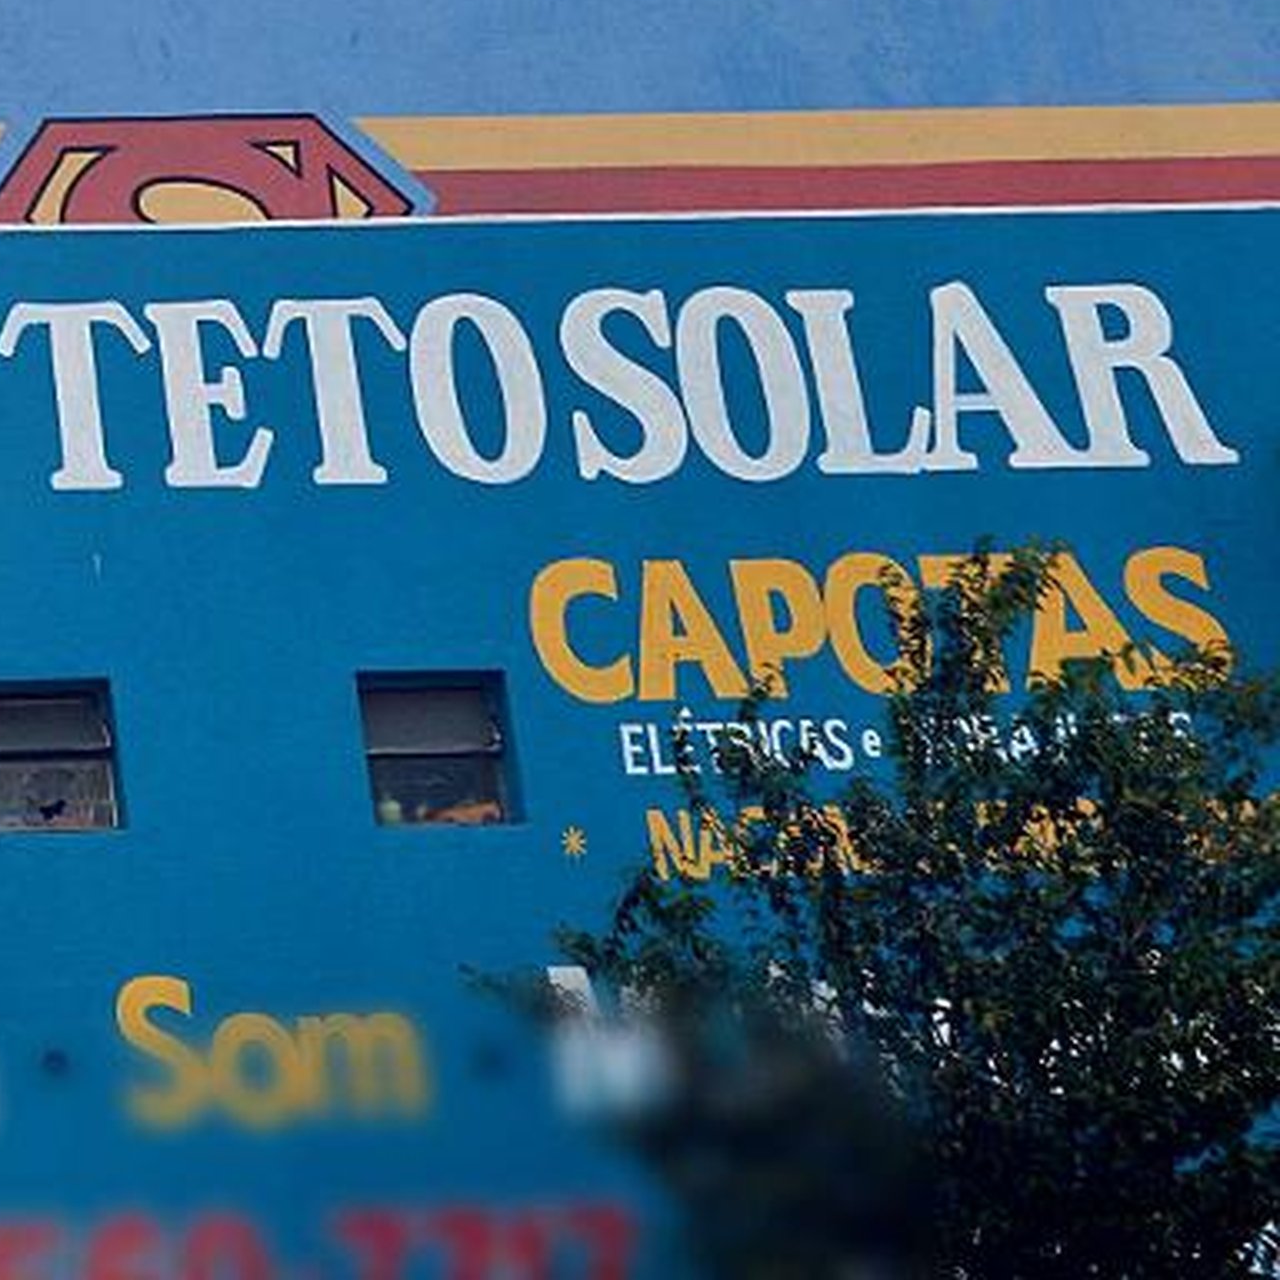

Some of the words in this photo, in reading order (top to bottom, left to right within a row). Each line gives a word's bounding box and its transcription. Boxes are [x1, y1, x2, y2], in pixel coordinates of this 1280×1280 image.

[559, 281, 1239, 483] SOLAR
[529, 546, 1233, 704] CAPOTAS
[114, 975, 425, 1125] Som
